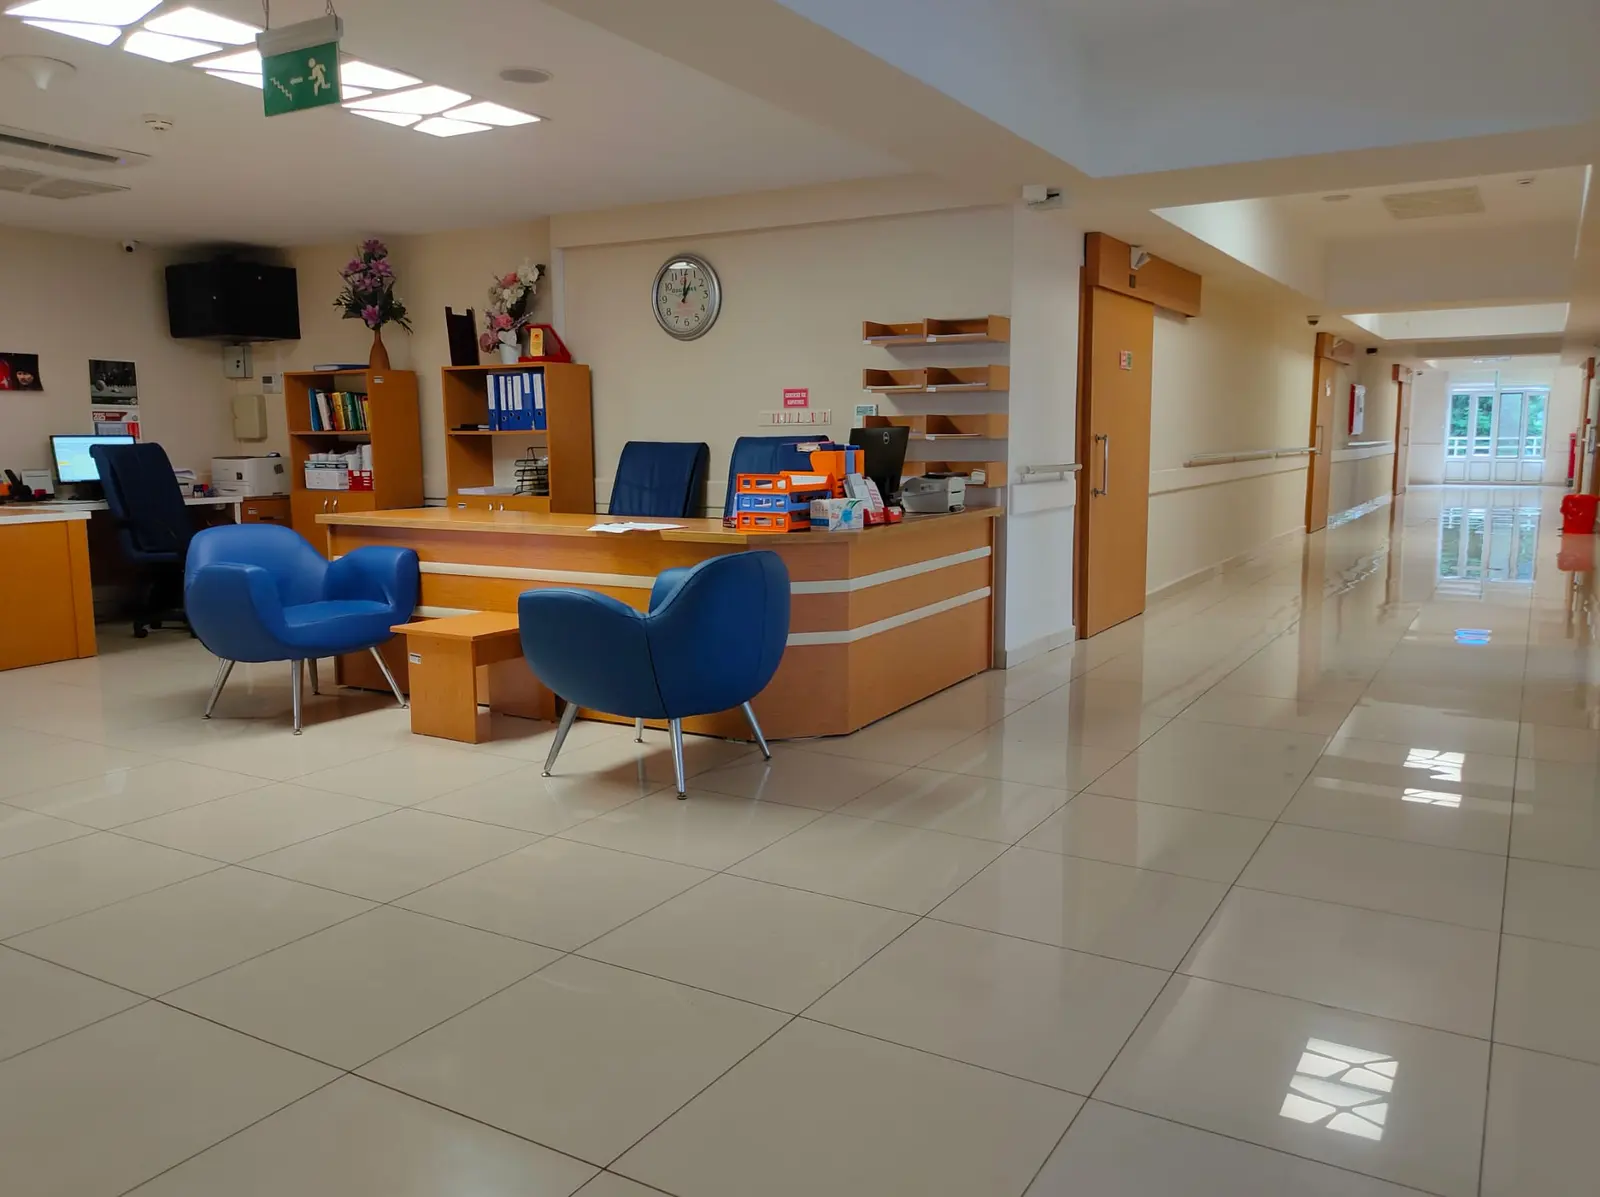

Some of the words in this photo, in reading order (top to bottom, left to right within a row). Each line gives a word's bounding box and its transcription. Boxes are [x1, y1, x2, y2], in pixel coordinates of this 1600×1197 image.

[671, 272, 678, 281] 11
[680, 268, 688, 276] 12
[665, 283, 673, 292] 10
[699, 279, 704, 287] 2
[703, 290, 709, 299] 3
[662, 295, 667, 304] 9
[666, 308, 672, 316] 8
[700, 304, 705, 312] 4
[674, 315, 679, 324] 7
[694, 313, 700, 322] 5
[684, 318, 690, 327] 6
